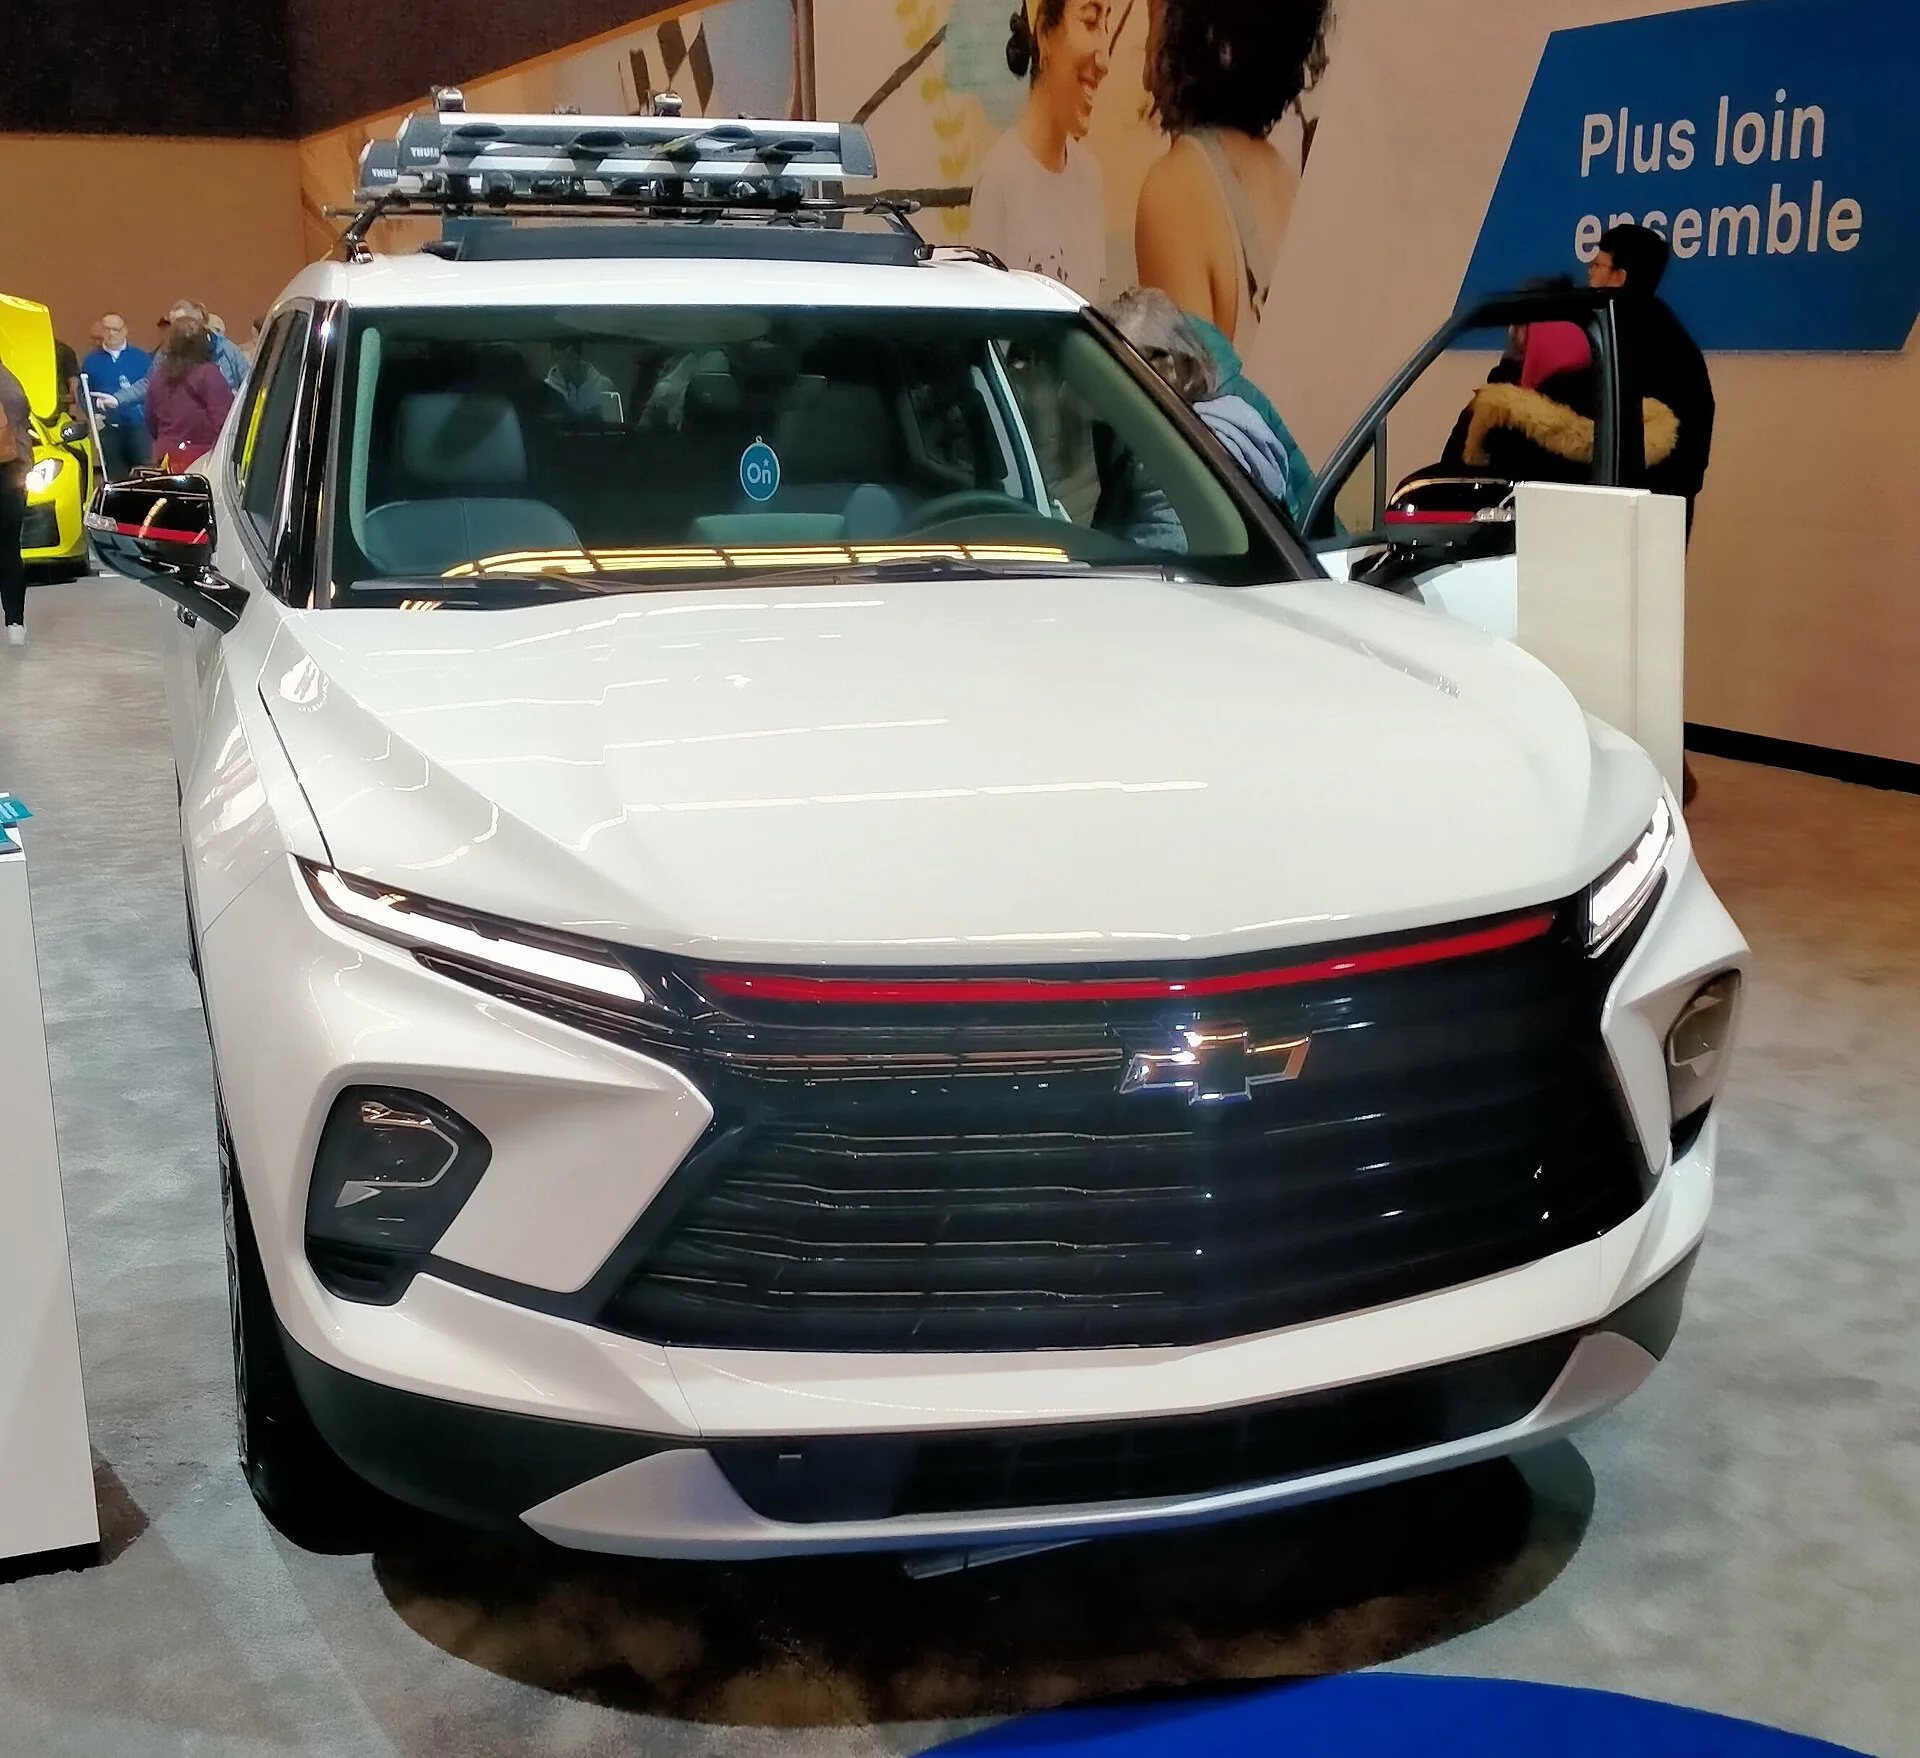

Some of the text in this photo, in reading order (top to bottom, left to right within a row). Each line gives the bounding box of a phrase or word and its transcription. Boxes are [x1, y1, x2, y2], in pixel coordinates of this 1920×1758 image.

[1580, 88, 1825, 177] Plus loin
[746, 459, 772, 484] On
